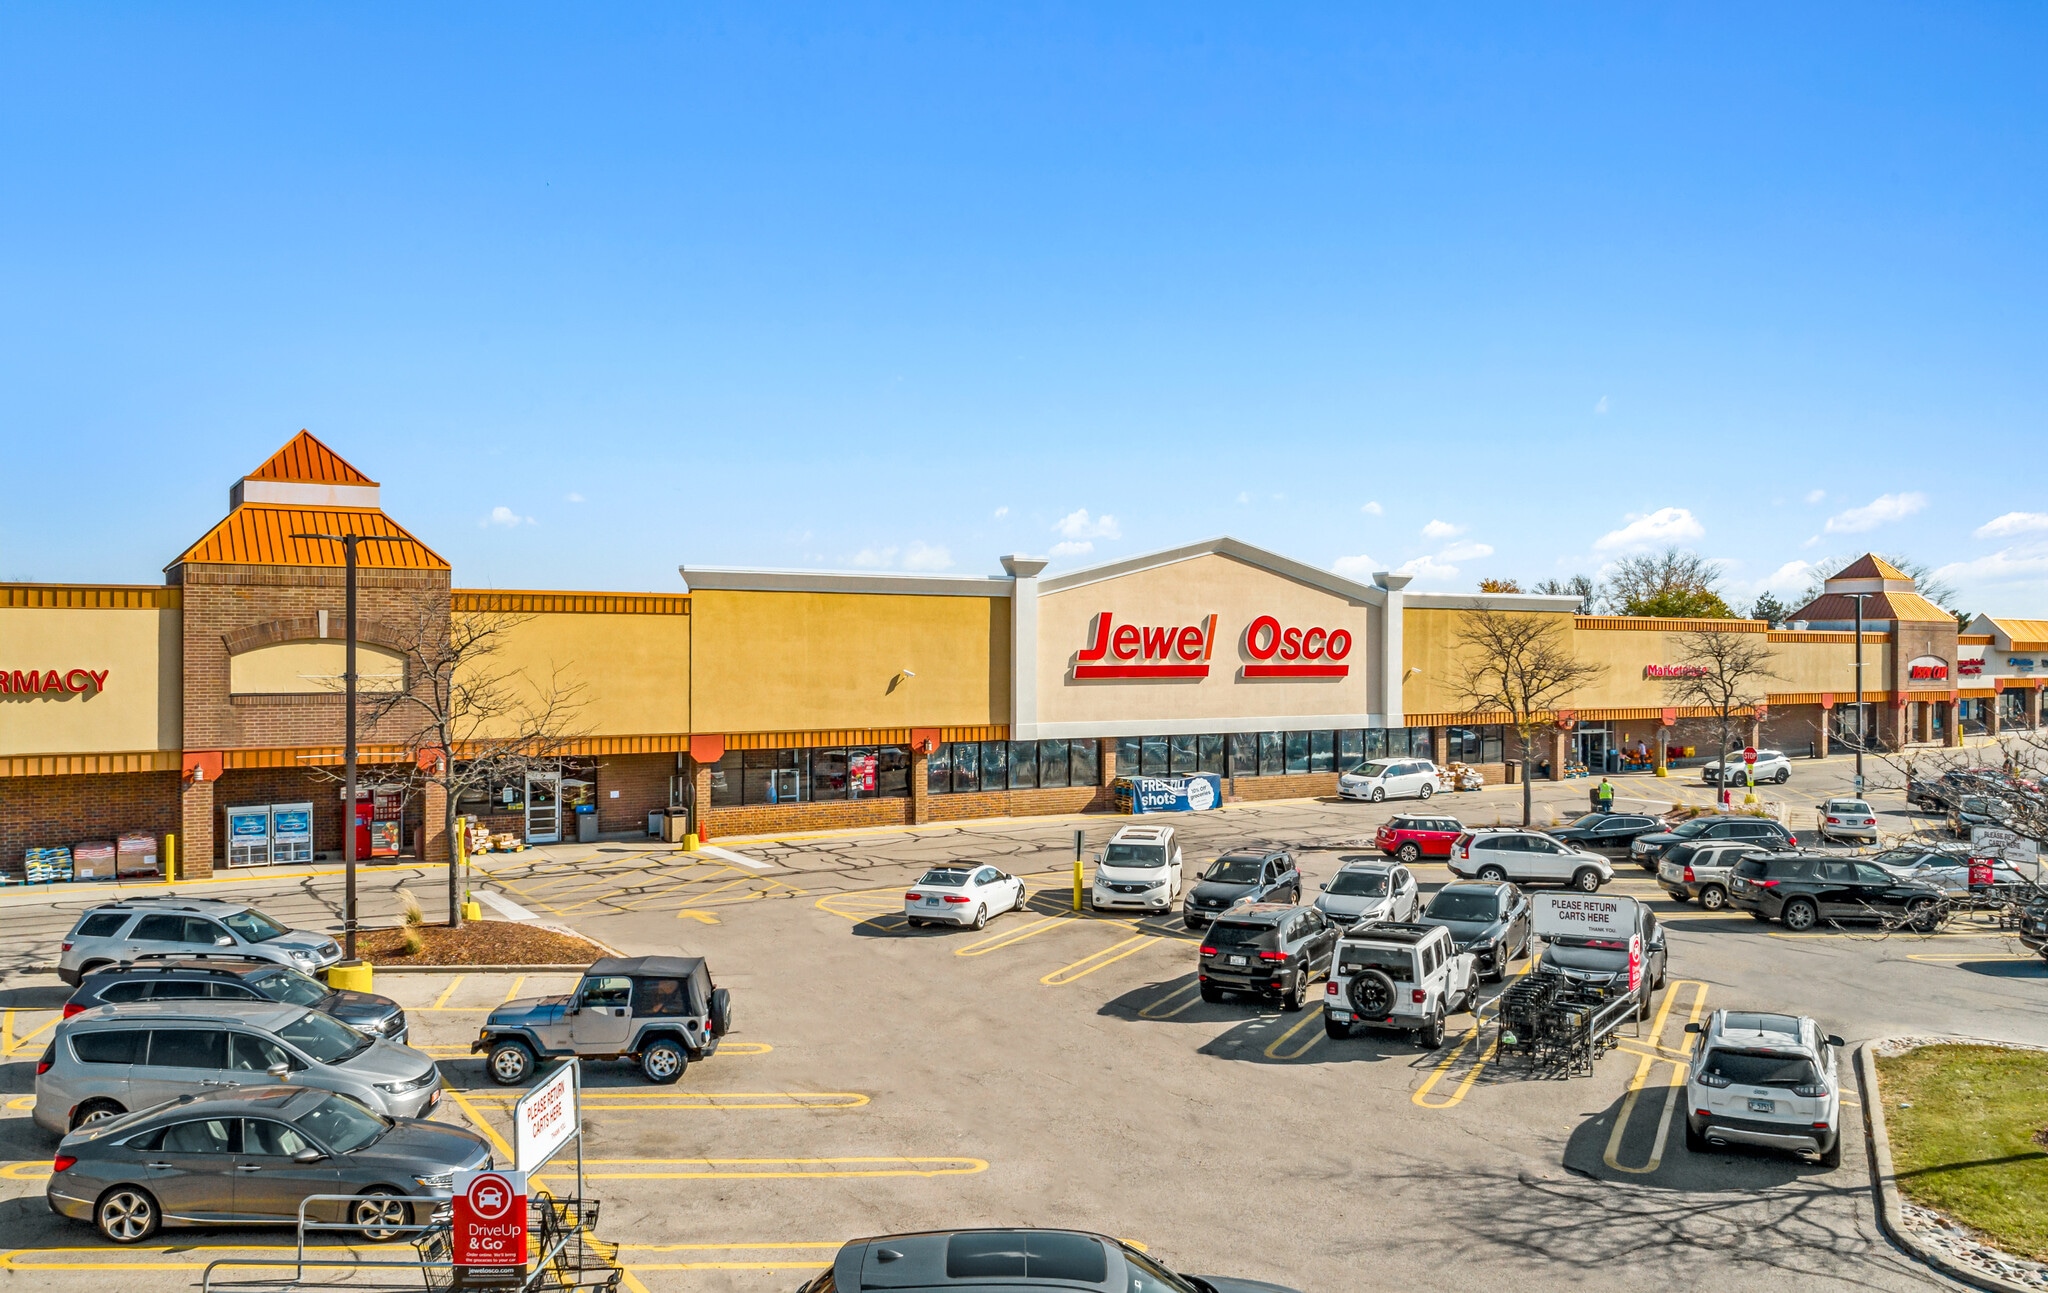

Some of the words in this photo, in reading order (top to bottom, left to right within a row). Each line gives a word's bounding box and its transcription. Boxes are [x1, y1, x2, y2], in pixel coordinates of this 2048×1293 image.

[1077, 612, 1218, 661] Jewel
[1246, 615, 1352, 661] Osco
[1744, 752, 1757, 760] STOP
[1142, 779, 1168, 792] FREE
[1142, 793, 1177, 806] shots
[1552, 900, 1582, 910] PLEASE
[1584, 902, 1617, 912] RETURN
[1559, 911, 1585, 921] CARTS
[1588, 913, 1609, 923] HERE
[527, 1095, 546, 1123] PLEASE
[547, 1080, 565, 1107] RETURN
[533, 1113, 549, 1138] CARTS
[550, 1101, 562, 1123] HERE
[469, 1223, 521, 1239] DriveUp
[469, 1237, 480, 1250] &
[468, 1267, 514, 1275] jewelosco.com
